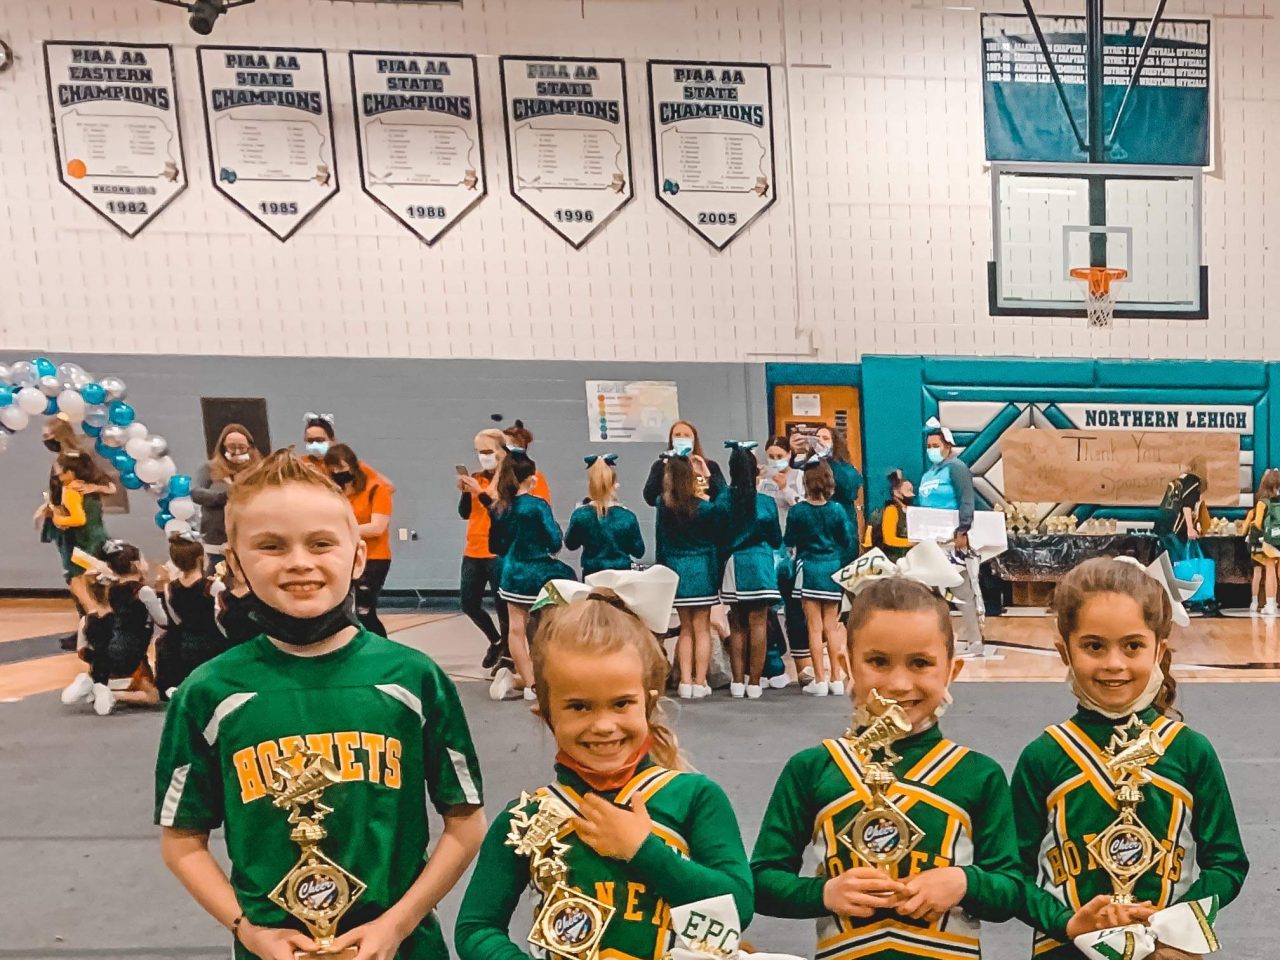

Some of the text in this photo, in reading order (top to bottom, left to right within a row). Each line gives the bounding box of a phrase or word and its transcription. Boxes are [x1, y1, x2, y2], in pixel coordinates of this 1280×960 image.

[72, 49, 147, 66] PIAA AA
[225, 54, 300, 70] PIAA AA
[68, 66, 153, 83] EASTERN
[377, 59, 451, 75] PIAA AA
[526, 63, 599, 80] PIAA AA
[236, 72, 294, 87] STATE
[674, 68, 745, 84] PIAA AA
[386, 77, 444, 92] STATE
[536, 82, 593, 97] STATE
[57, 84, 170, 111] CHAMPIONS
[683, 86, 738, 101] STATE
[211, 89, 322, 115] CHAMPIONS
[362, 93, 472, 120] CHAMPIONS
[513, 98, 620, 124] CHAMPIONS
[659, 102, 764, 128] CHAMPIONS
[107, 201, 149, 214] 1982
[260, 201, 298, 214] 1985
[407, 206, 446, 218] 1988
[555, 210, 594, 222] 1996
[699, 212, 737, 224] 2005
[1085, 409, 1247, 429] NORTHERN LEHIGH
[1062, 432, 1161, 463] Thank You
[299, 880, 337, 899] Cheer
[681, 910, 740, 955] EPC
